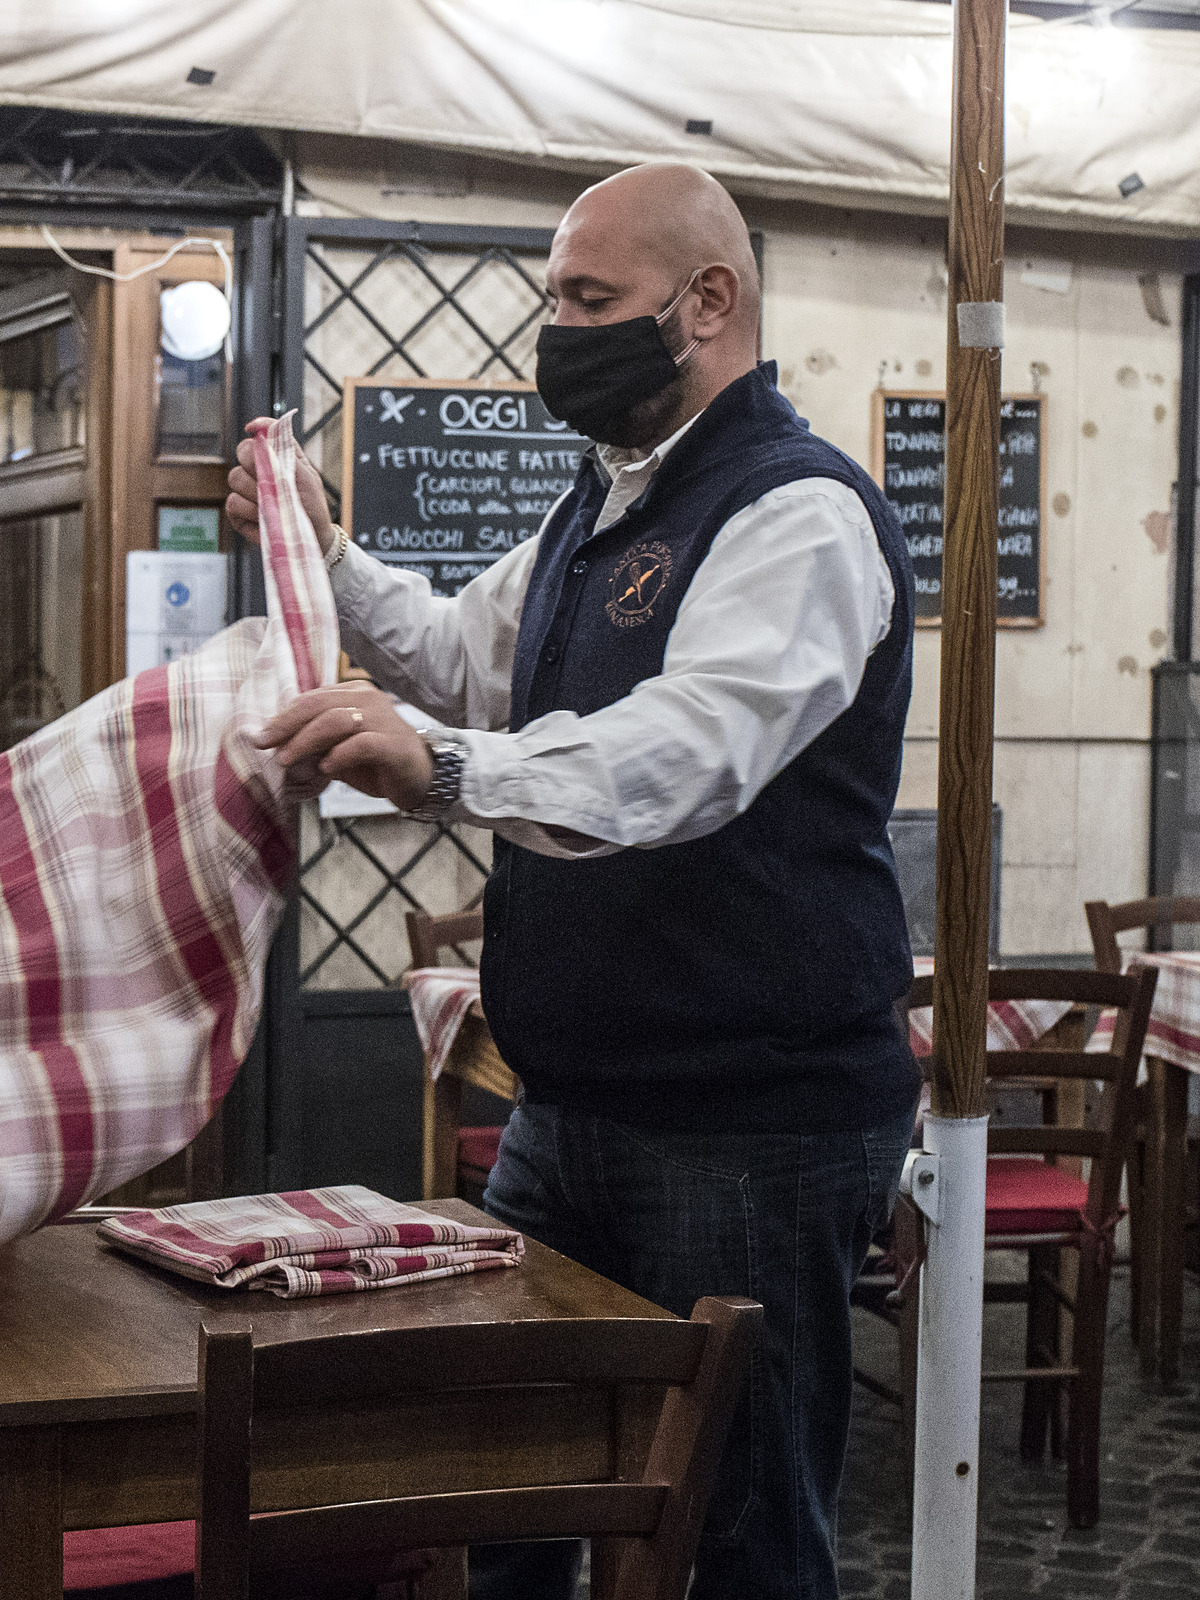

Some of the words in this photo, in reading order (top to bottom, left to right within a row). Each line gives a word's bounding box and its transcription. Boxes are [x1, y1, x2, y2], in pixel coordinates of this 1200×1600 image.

[439, 394, 527, 430] OGGI
[378, 444, 509, 471] FETTUCCINE
[519, 450, 580, 471] FATTE
[376, 525, 464, 550] GNOCCHI
